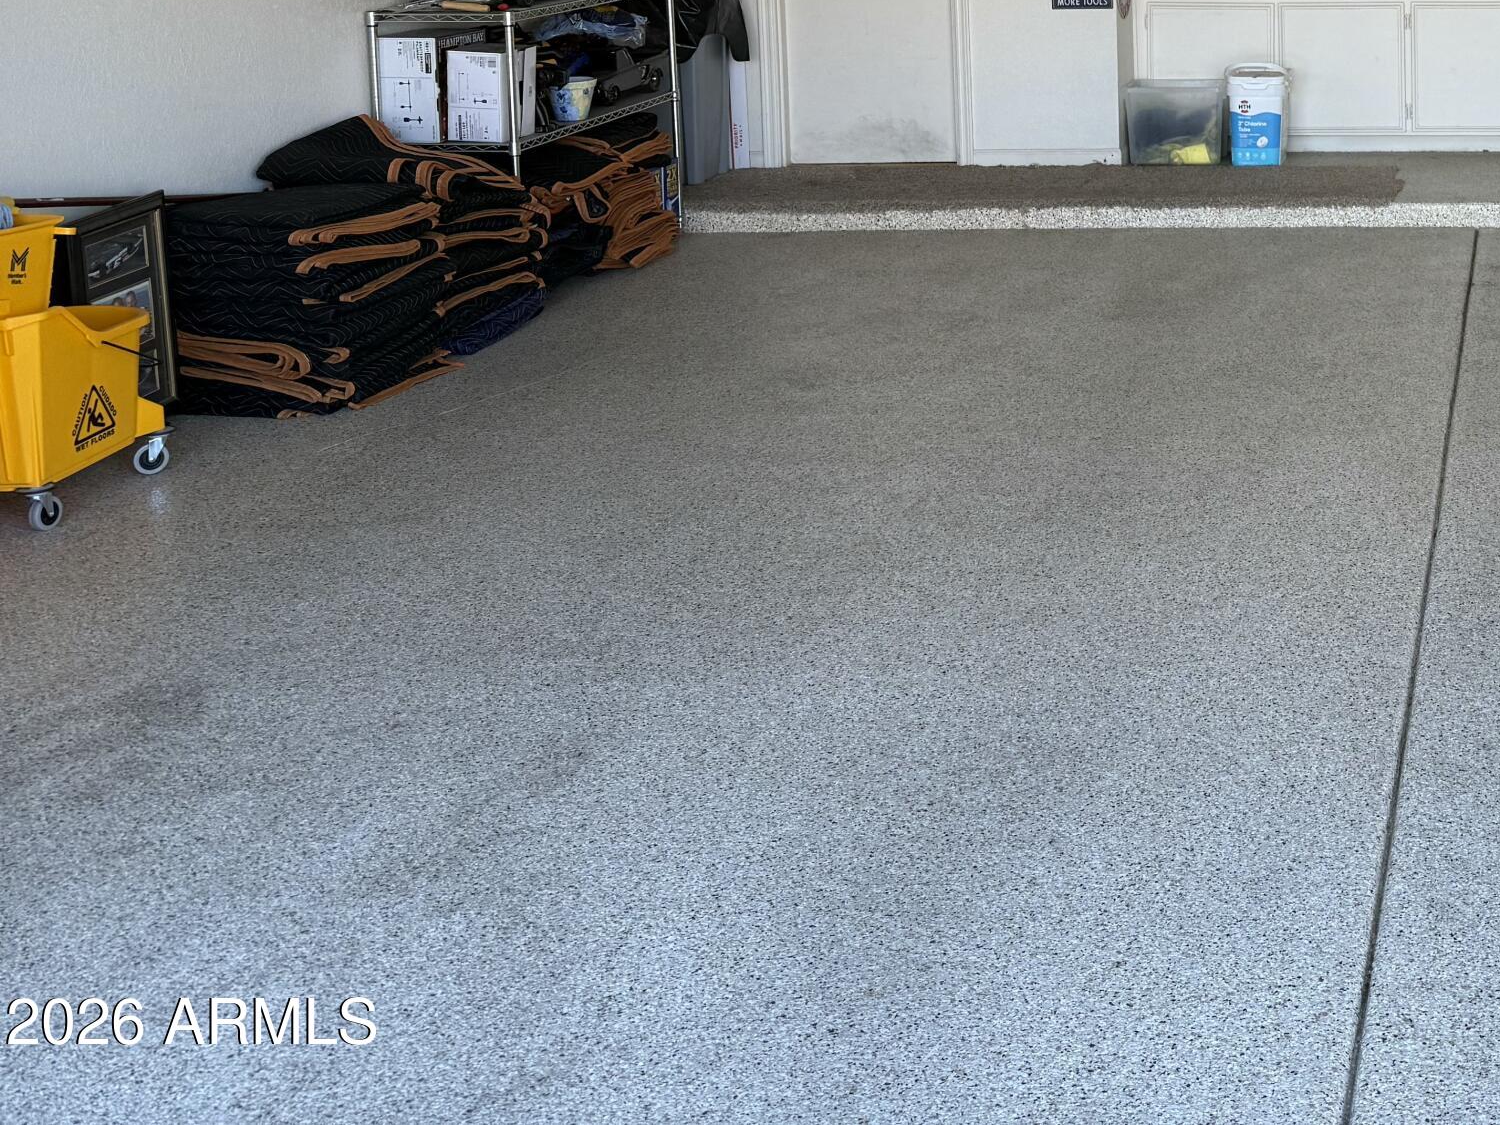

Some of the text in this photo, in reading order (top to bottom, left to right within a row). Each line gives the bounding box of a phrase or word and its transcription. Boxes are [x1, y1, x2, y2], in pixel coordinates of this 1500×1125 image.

[441, 32, 484, 48] HAMPTON BAY
[72, 393, 89, 437] CAUTION
[99, 385, 117, 417] CUIDADO
[75, 429, 116, 453] WET FLOORS
